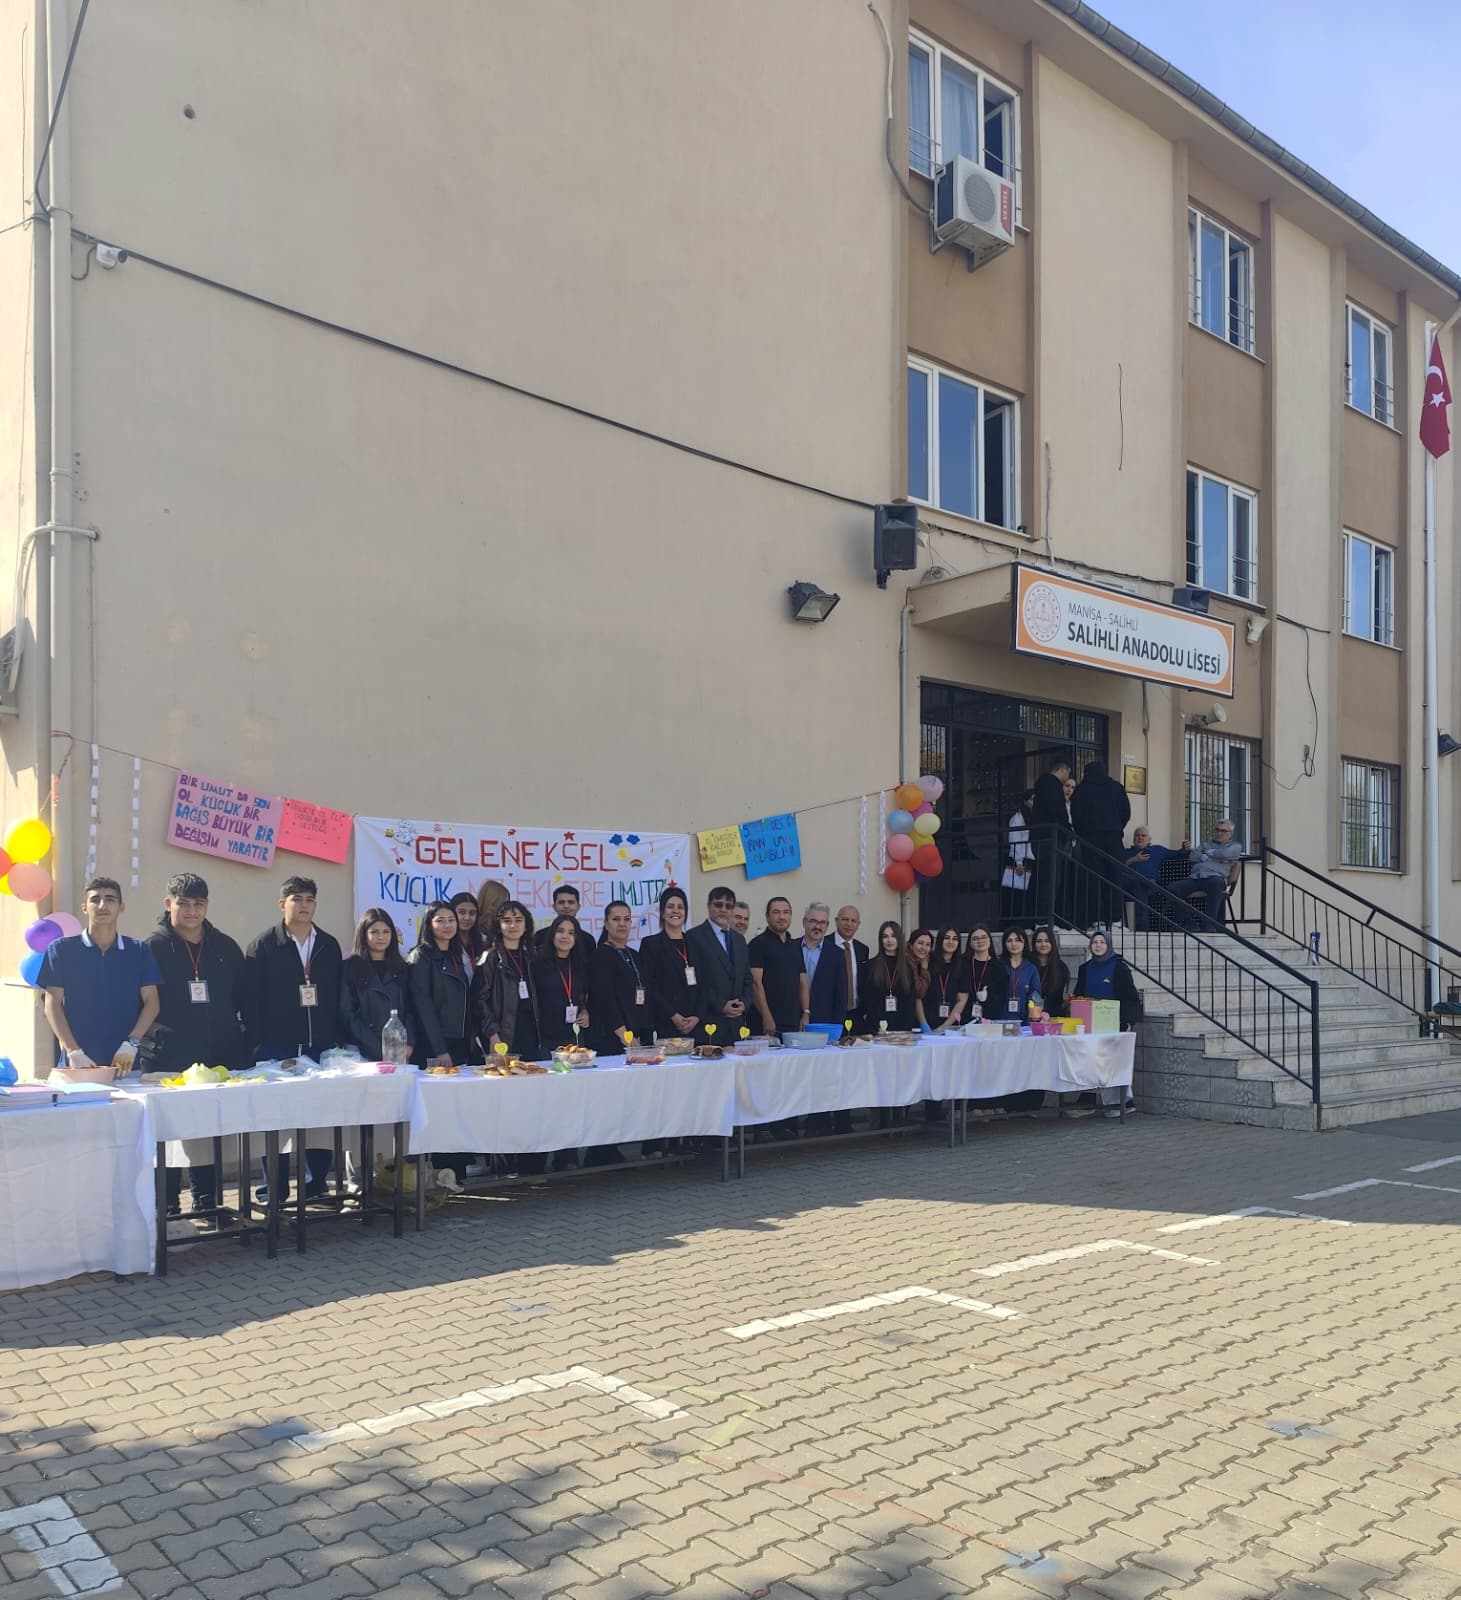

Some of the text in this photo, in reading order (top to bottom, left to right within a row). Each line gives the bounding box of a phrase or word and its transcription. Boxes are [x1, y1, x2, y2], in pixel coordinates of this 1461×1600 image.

[1068, 602, 1101, 621] MANİSA
[1108, 612, 1138, 632] SALİHLİ
[1068, 621, 1221, 675] SALİHLİ ANADOLU LİSESİ
[178, 788, 193, 804] OL
[200, 781, 233, 797] UMUT
[237, 791, 248, 802] DA
[415, 835, 618, 872] GELENEKSEL
[379, 872, 452, 907] KÜÇÜK
